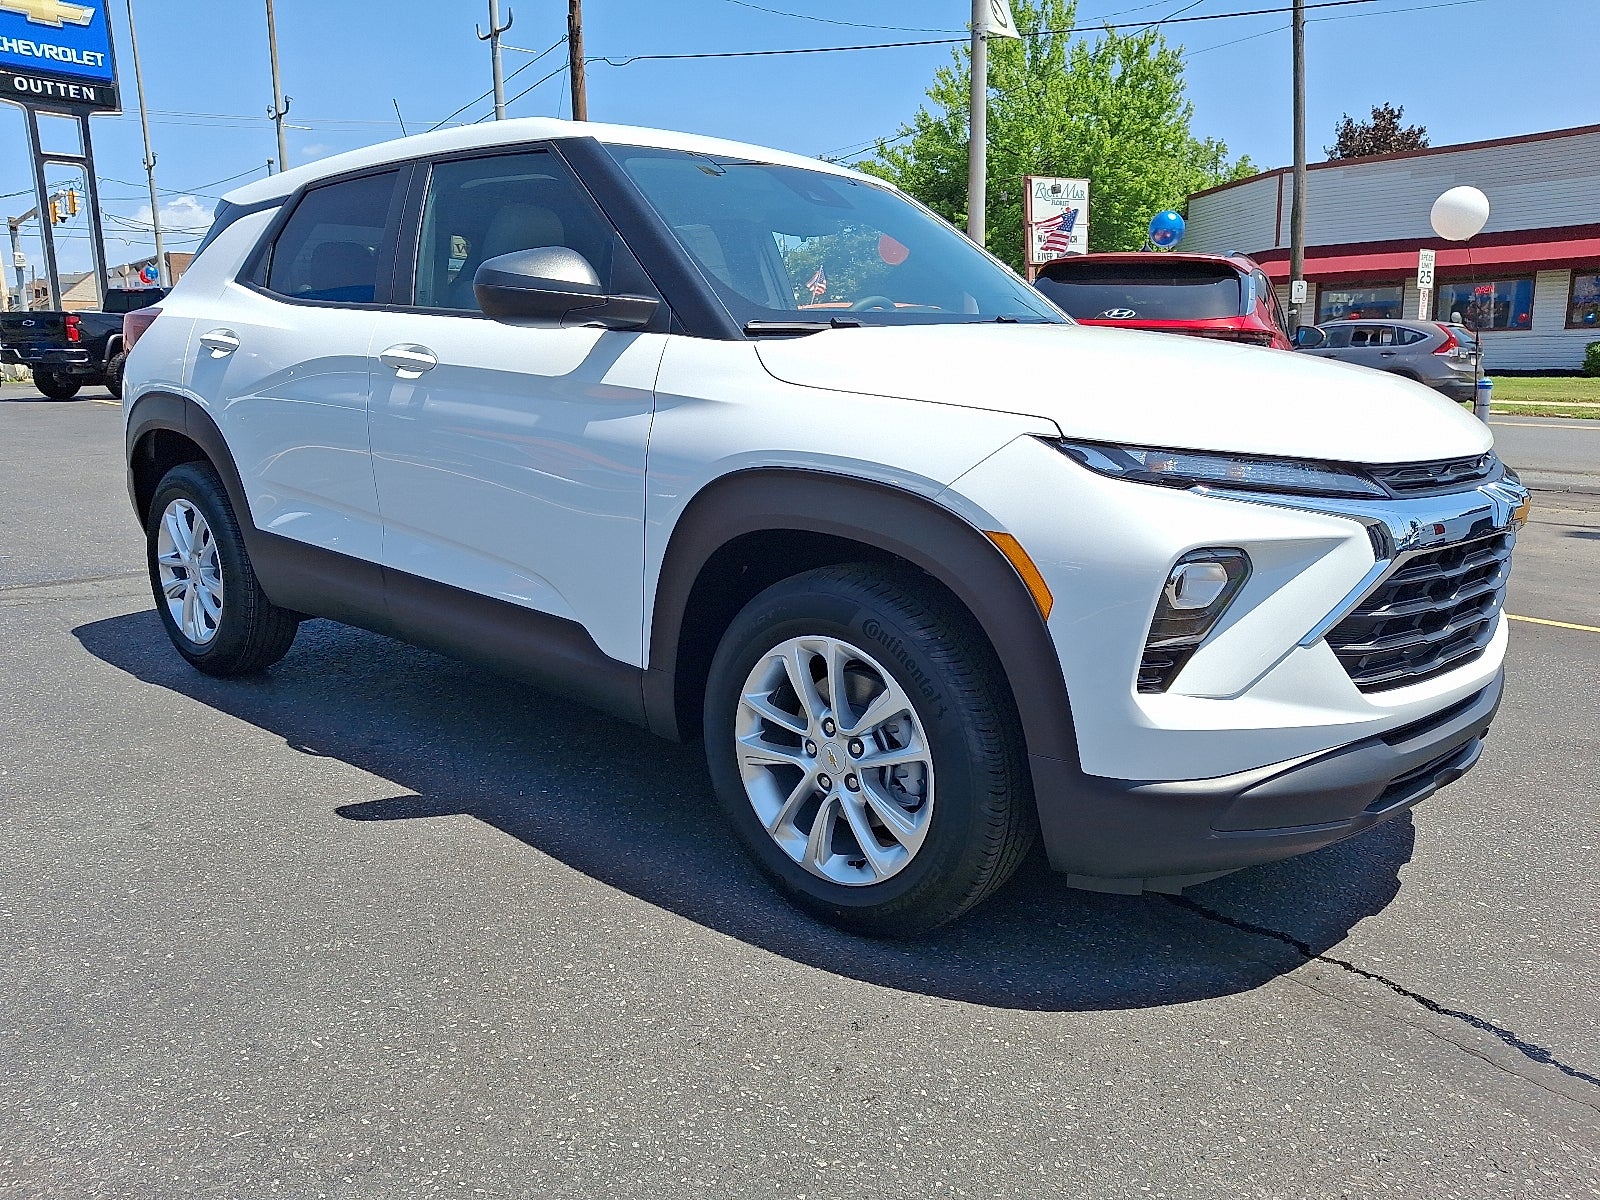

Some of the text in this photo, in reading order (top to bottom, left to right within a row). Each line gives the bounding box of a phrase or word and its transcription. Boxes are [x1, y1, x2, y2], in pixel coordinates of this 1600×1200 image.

[0, 36, 104, 67] HEVROLET
[13, 76, 95, 100] OUTTEN
[1035, 182, 1059, 200] RIC
[1421, 253, 1434, 262] SPEED
[1419, 270, 1432, 284] 25
[862, 618, 942, 704] Continental
